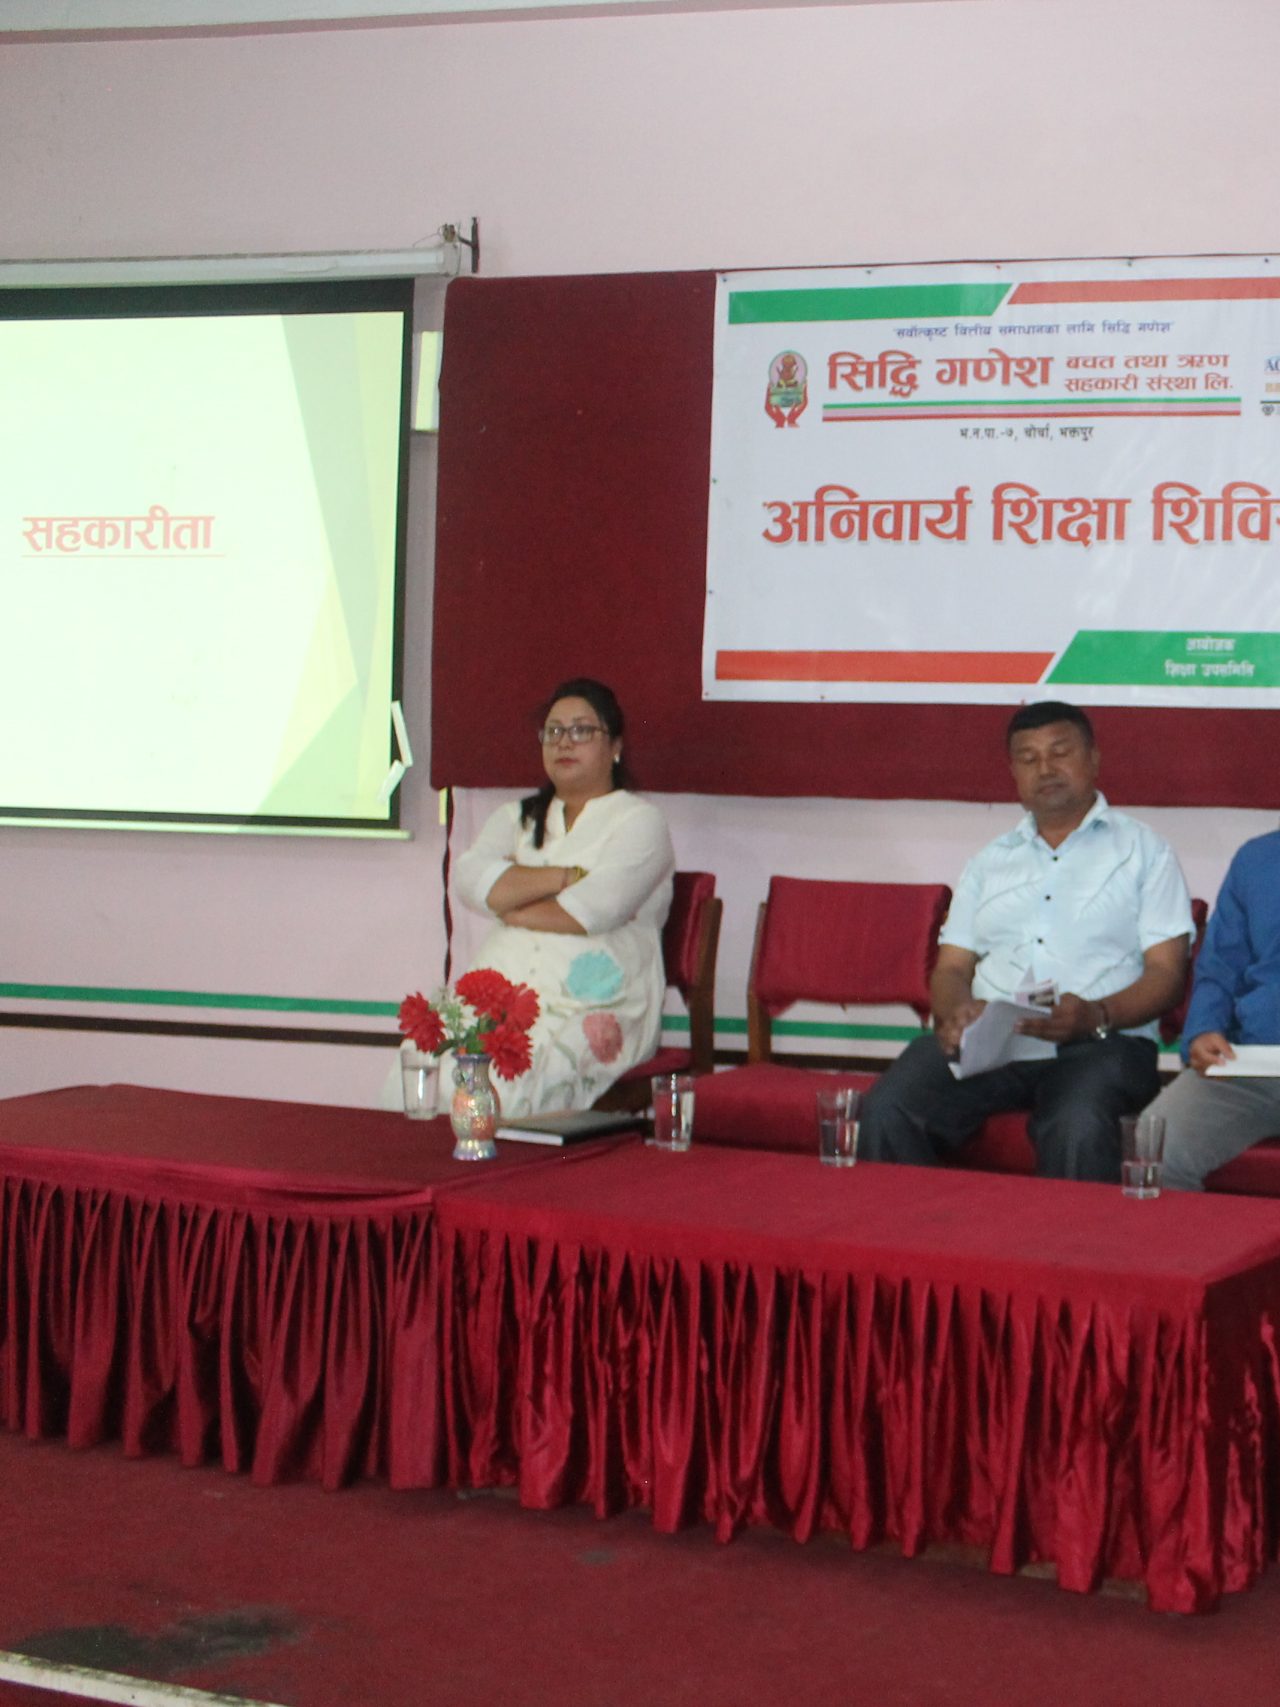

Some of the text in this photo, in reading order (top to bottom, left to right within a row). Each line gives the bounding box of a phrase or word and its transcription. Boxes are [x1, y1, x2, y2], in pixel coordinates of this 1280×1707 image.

[827, 348, 1054, 398] सिद्धि गणेश
[1066, 354, 1229, 369] बचत तथा ऋण
[1064, 372, 1233, 392] सहकारी संस्था लि.
[1059, 426, 1094, 441] भक्तपुर
[22, 505, 215, 552] सहकारीता
[762, 483, 972, 546] अनिवार्य
[991, 482, 1131, 548] शिक्षा
